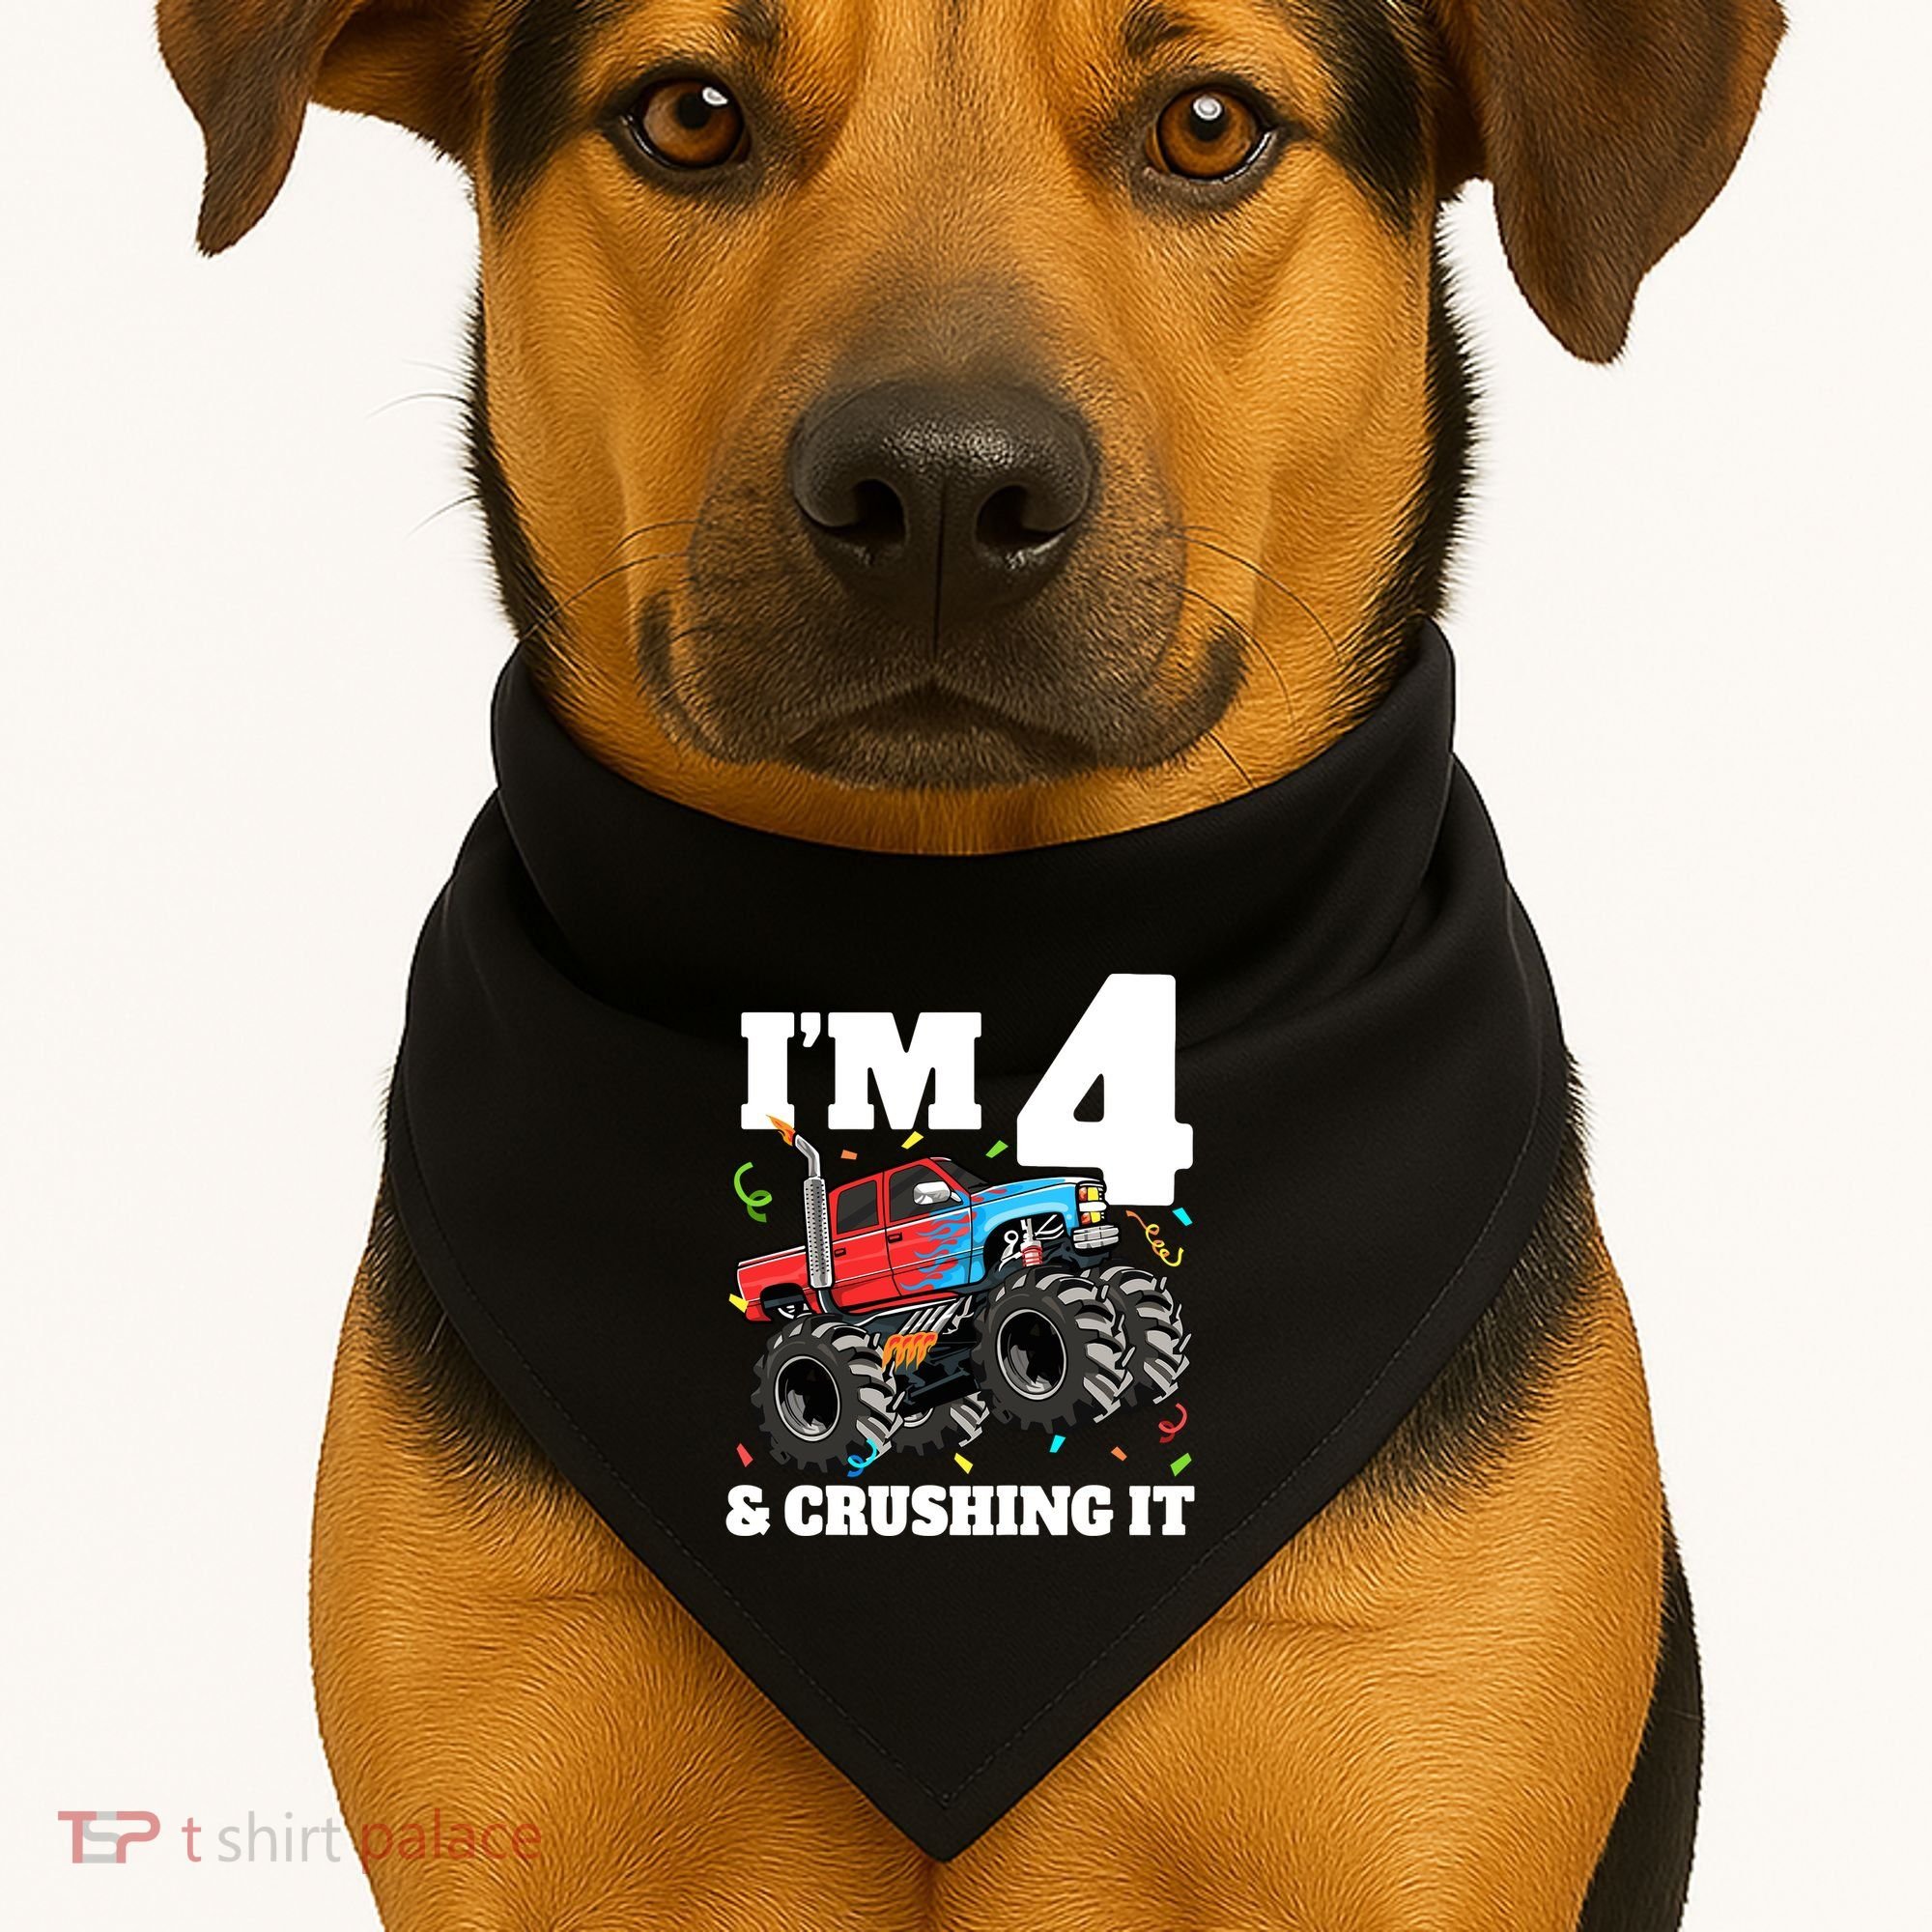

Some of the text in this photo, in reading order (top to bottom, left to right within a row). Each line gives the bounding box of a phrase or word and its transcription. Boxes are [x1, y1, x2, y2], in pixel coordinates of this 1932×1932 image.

[741, 973, 1194, 1207] I'M 4
[725, 1485, 1195, 1537] & CRUSHING IT
